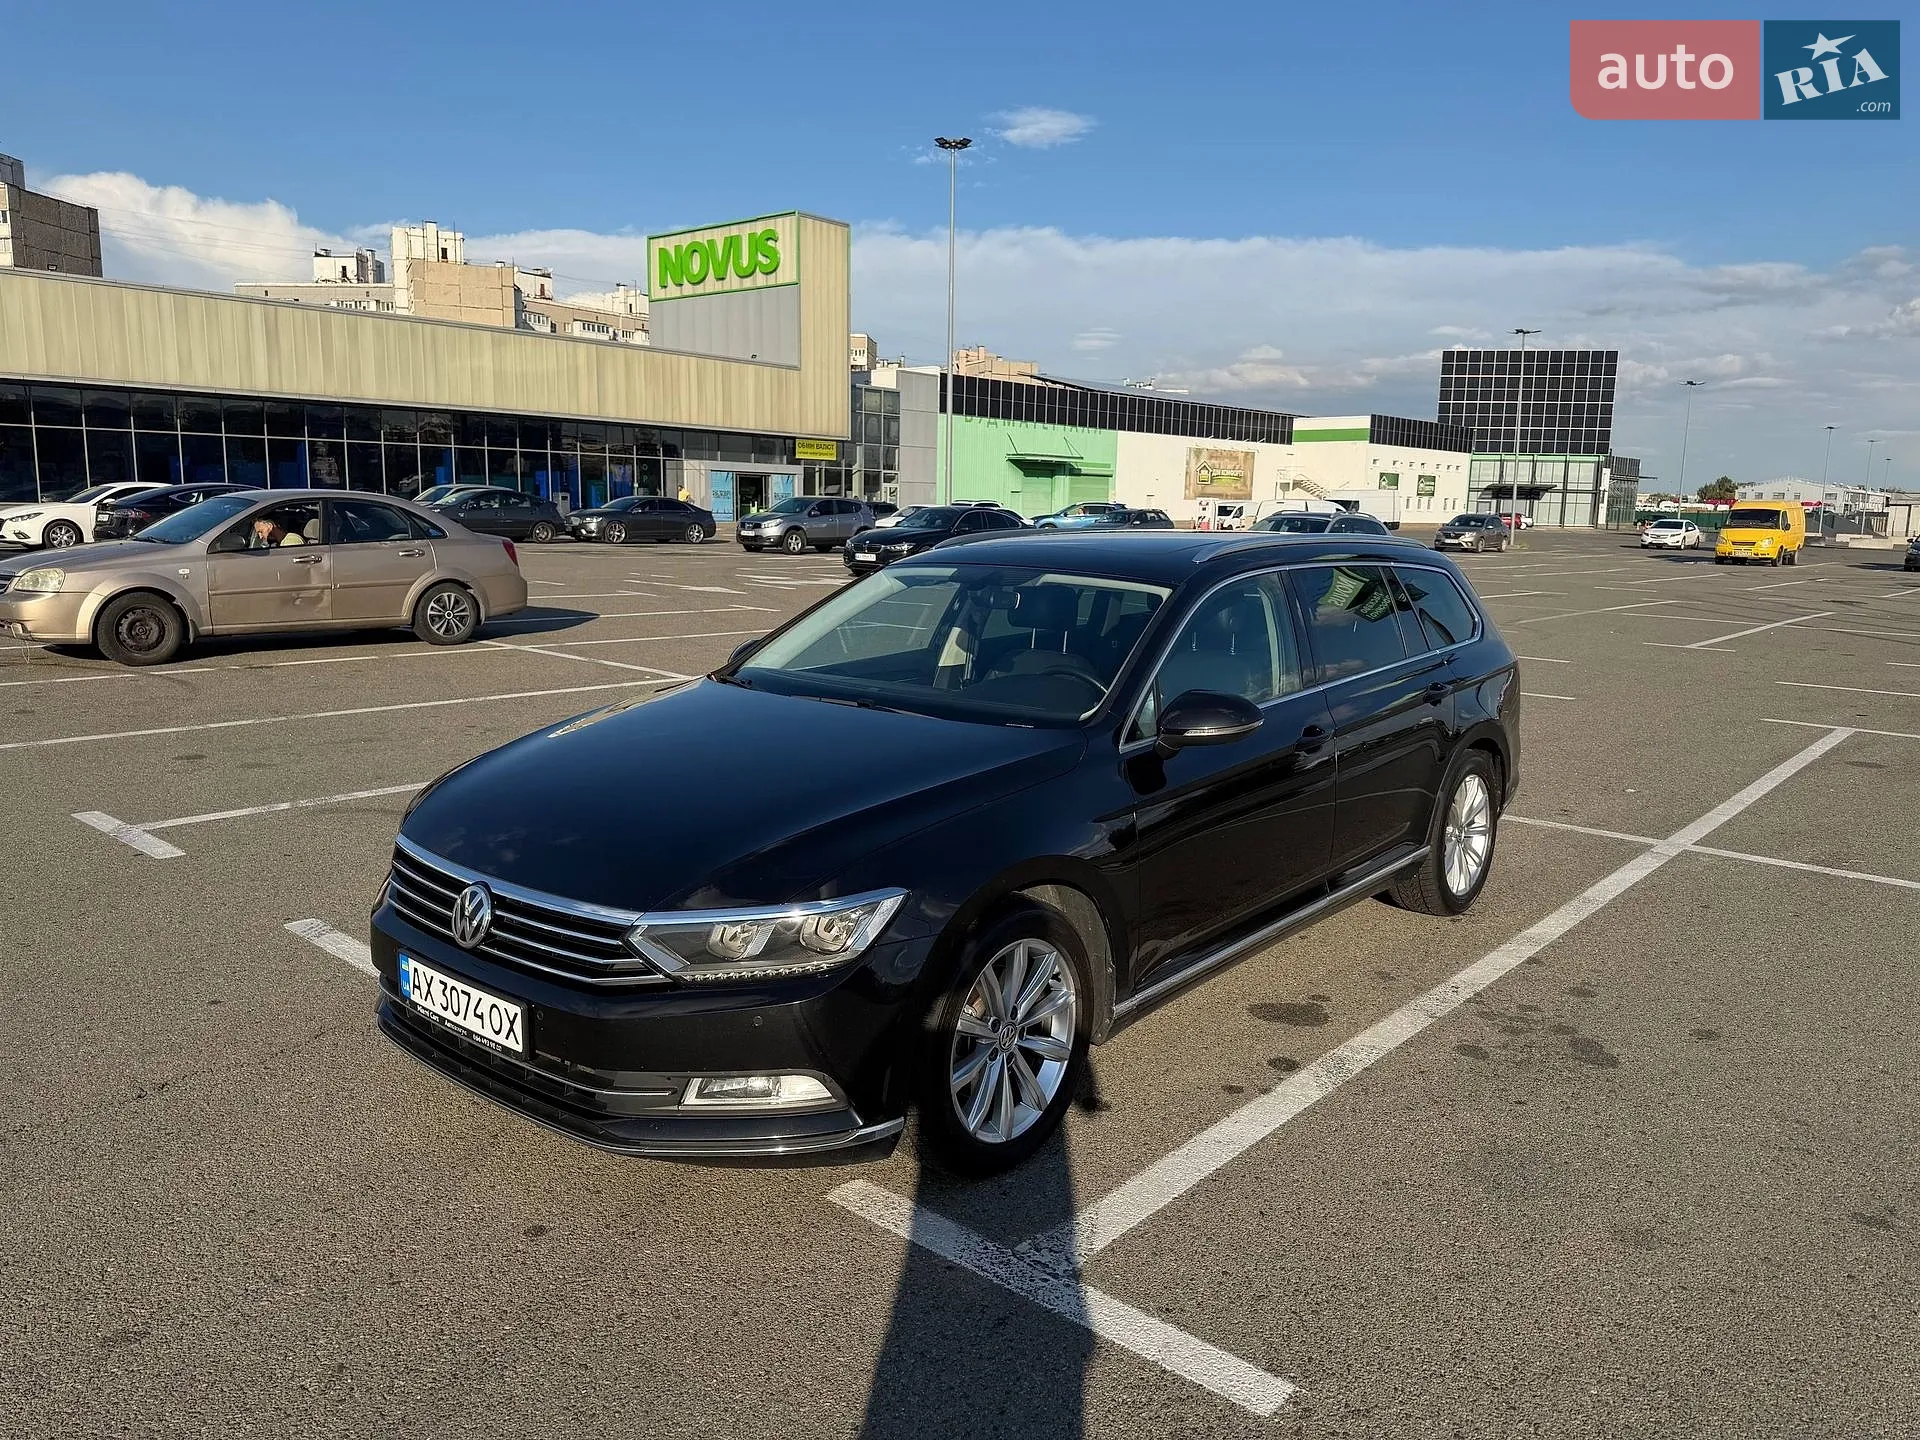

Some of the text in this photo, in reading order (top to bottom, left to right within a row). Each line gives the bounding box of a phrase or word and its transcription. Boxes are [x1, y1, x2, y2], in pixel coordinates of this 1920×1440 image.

[658, 228, 780, 289] NOVUS
[815, 443, 834, 451] ВАЛЮТ
[412, 967, 435, 1006] AX
[439, 979, 485, 1030] 3074
[489, 1003, 519, 1045] OX
